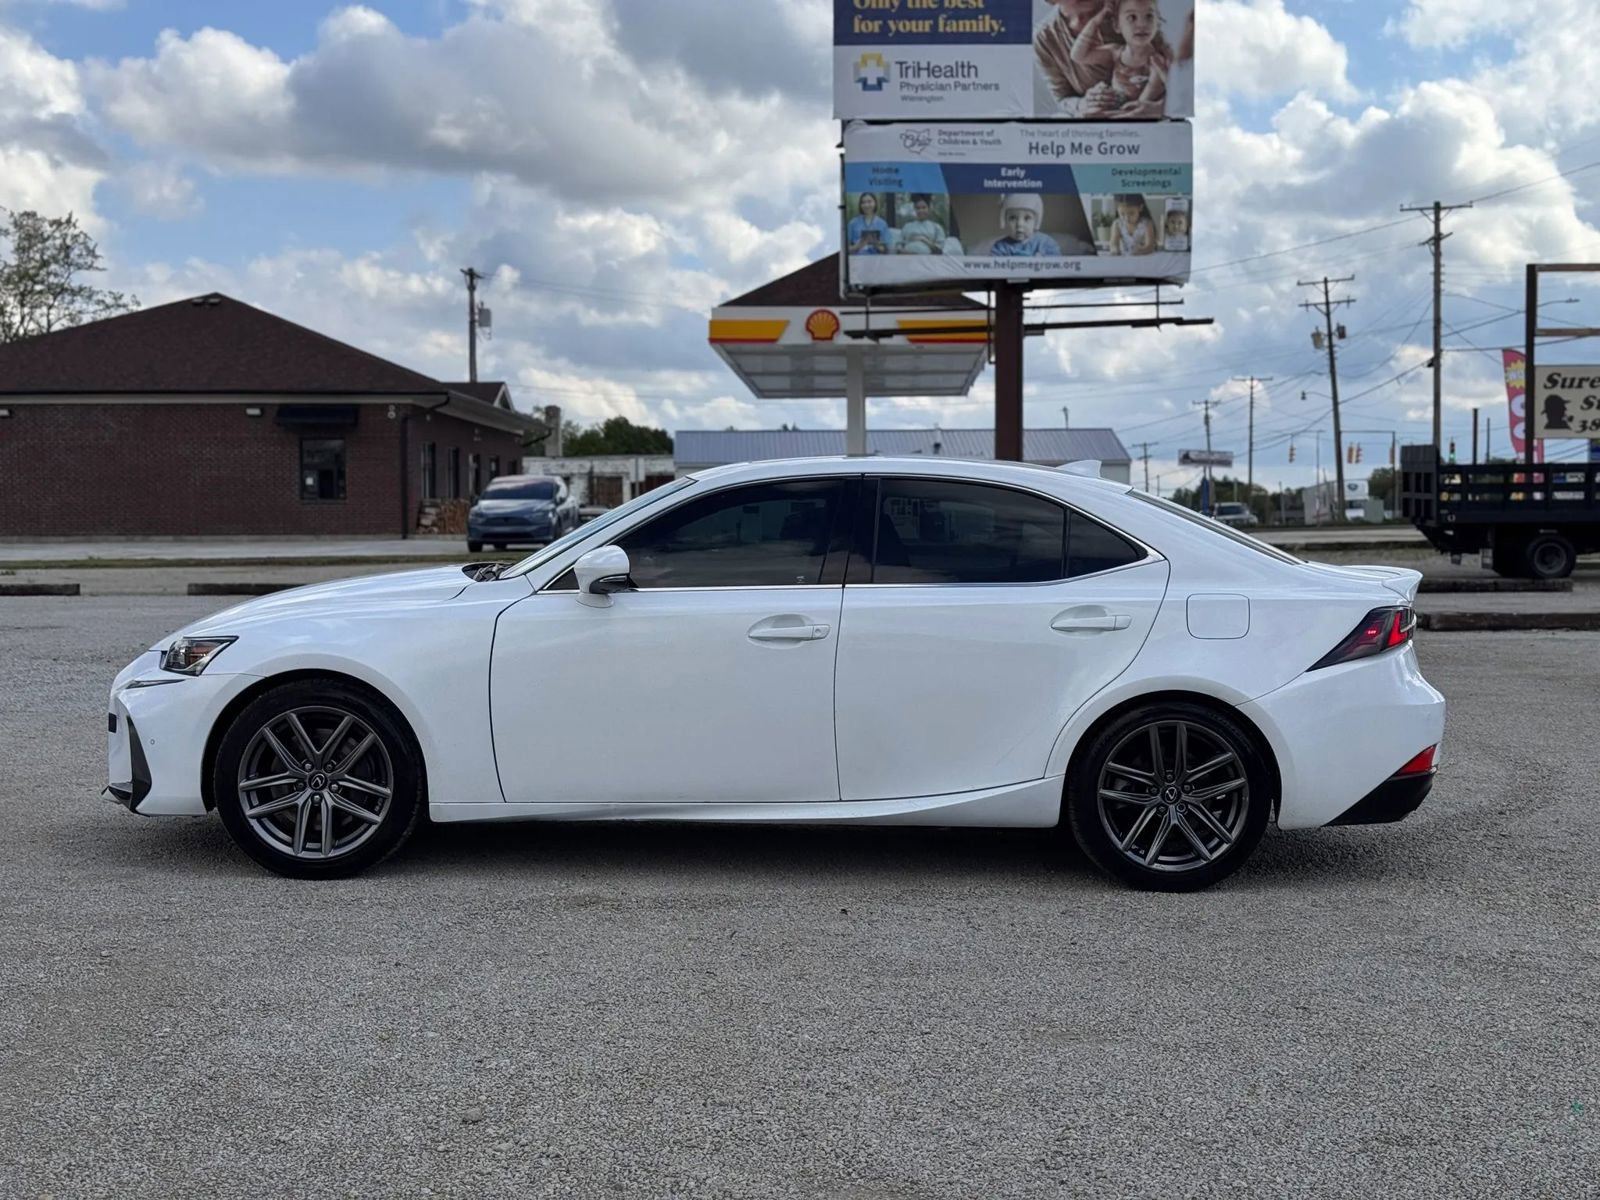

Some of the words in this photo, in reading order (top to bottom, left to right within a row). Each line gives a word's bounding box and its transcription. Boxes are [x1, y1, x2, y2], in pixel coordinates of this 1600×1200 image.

[854, 0, 899, 12] Only
[907, 0, 938, 9] the
[944, 0, 984, 9] best
[853, 14, 882, 33] for
[888, 19, 933, 37] your
[938, 14, 1006, 37] family.
[895, 61, 978, 79] TriHealth
[900, 81, 952, 93] Physician
[954, 81, 1000, 91] Partners
[938, 129, 984, 138] Department
[986, 129, 994, 137] of
[1020, 129, 1035, 137] The
[1037, 129, 1058, 137] heart
[1061, 129, 1070, 137] of
[938, 138, 970, 146] Children
[1028, 142, 1065, 158] Help
[1071, 142, 1093, 155] Me
[1098, 142, 1140, 155] Grow
[1001, 167, 1025, 178] Early
[1112, 168, 1182, 177] Developmental
[983, 179, 1042, 188] Intervention
[1121, 178, 1172, 188] Screenings
[963, 259, 1081, 271] www.helpmegrow.org
[1543, 372, 1600, 389] Sure
